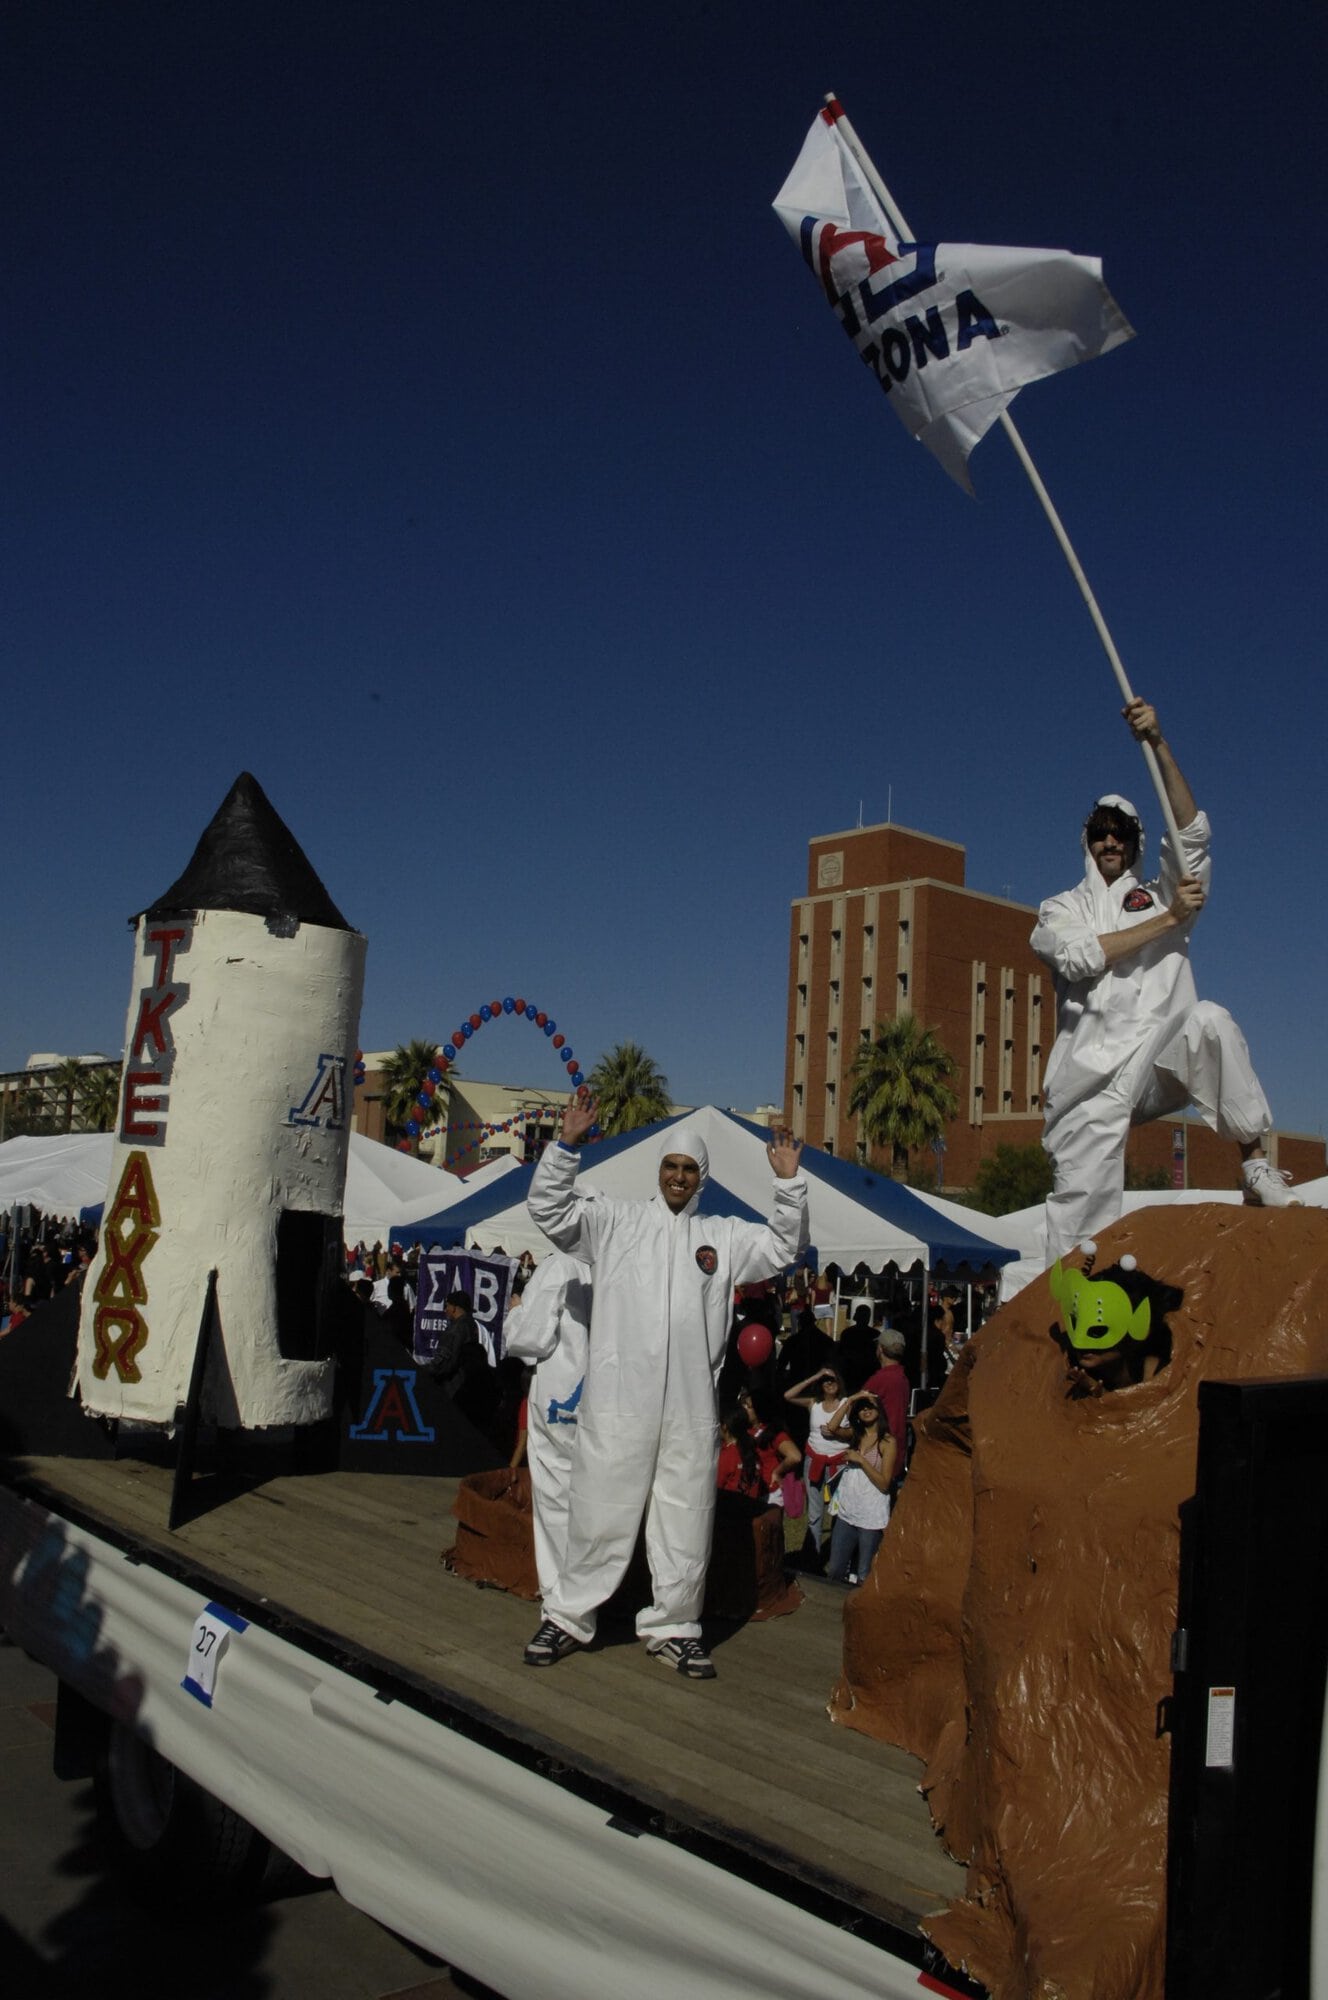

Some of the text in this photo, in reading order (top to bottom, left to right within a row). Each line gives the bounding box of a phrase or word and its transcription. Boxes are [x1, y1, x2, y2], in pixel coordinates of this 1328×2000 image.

[123, 928, 186, 1136] TKE
[289, 1053, 346, 1129] A
[348, 1367, 437, 1443] A
[195, 1625, 217, 1657] 27
